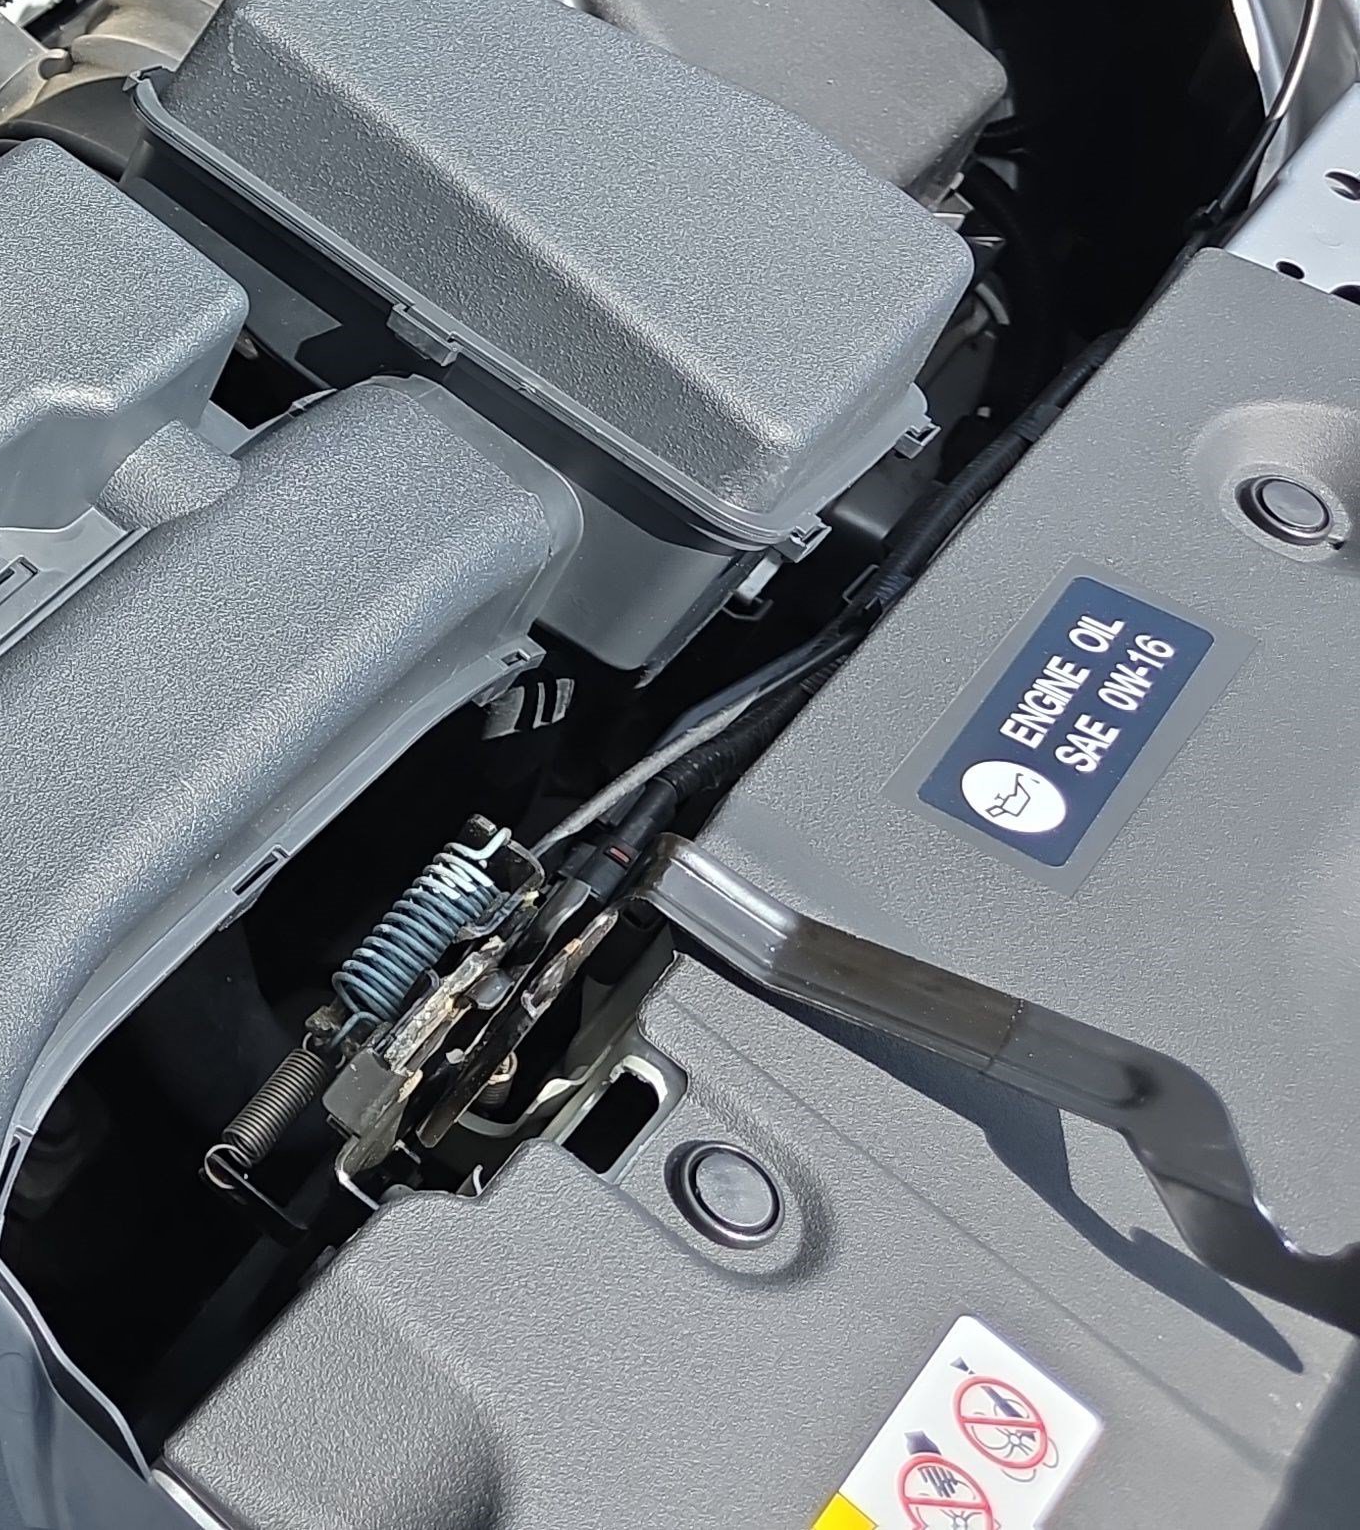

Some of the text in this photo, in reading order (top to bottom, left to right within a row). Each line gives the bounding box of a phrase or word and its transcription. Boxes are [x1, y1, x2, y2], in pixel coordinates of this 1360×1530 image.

[999, 615, 1126, 749] ENGINE OIL
[1054, 634, 1176, 772] SAE 0W-16
